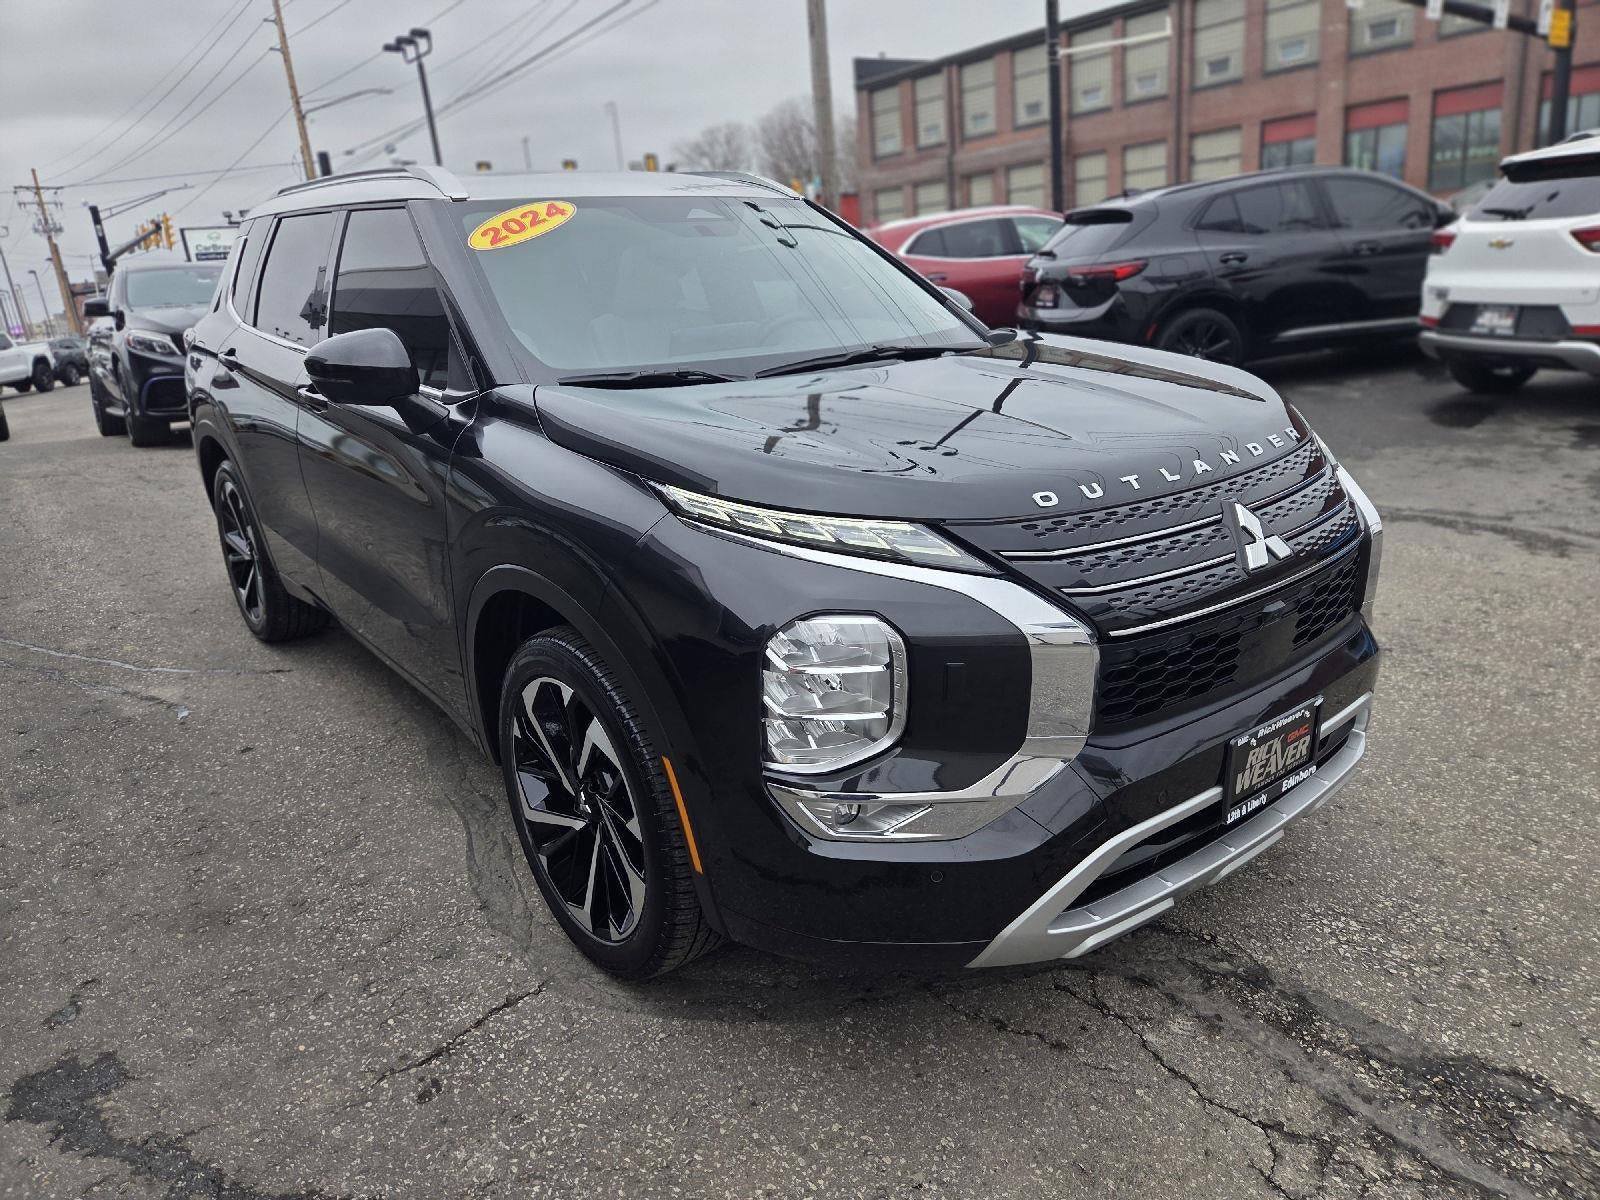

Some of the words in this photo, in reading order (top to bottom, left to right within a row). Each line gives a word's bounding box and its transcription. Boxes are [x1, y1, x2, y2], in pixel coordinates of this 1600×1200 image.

[480, 202, 568, 246] 2024
[1032, 427, 1301, 507] OUTLANDER
[1235, 734, 1311, 794] WEAVER
[1246, 734, 1284, 770] RICK
[1287, 724, 1310, 742] GMC
[1226, 805, 1241, 824] 12th
[1241, 804, 1247, 816] &
[1247, 793, 1268, 811] Liberty
[1281, 765, 1317, 792] Edinboro
